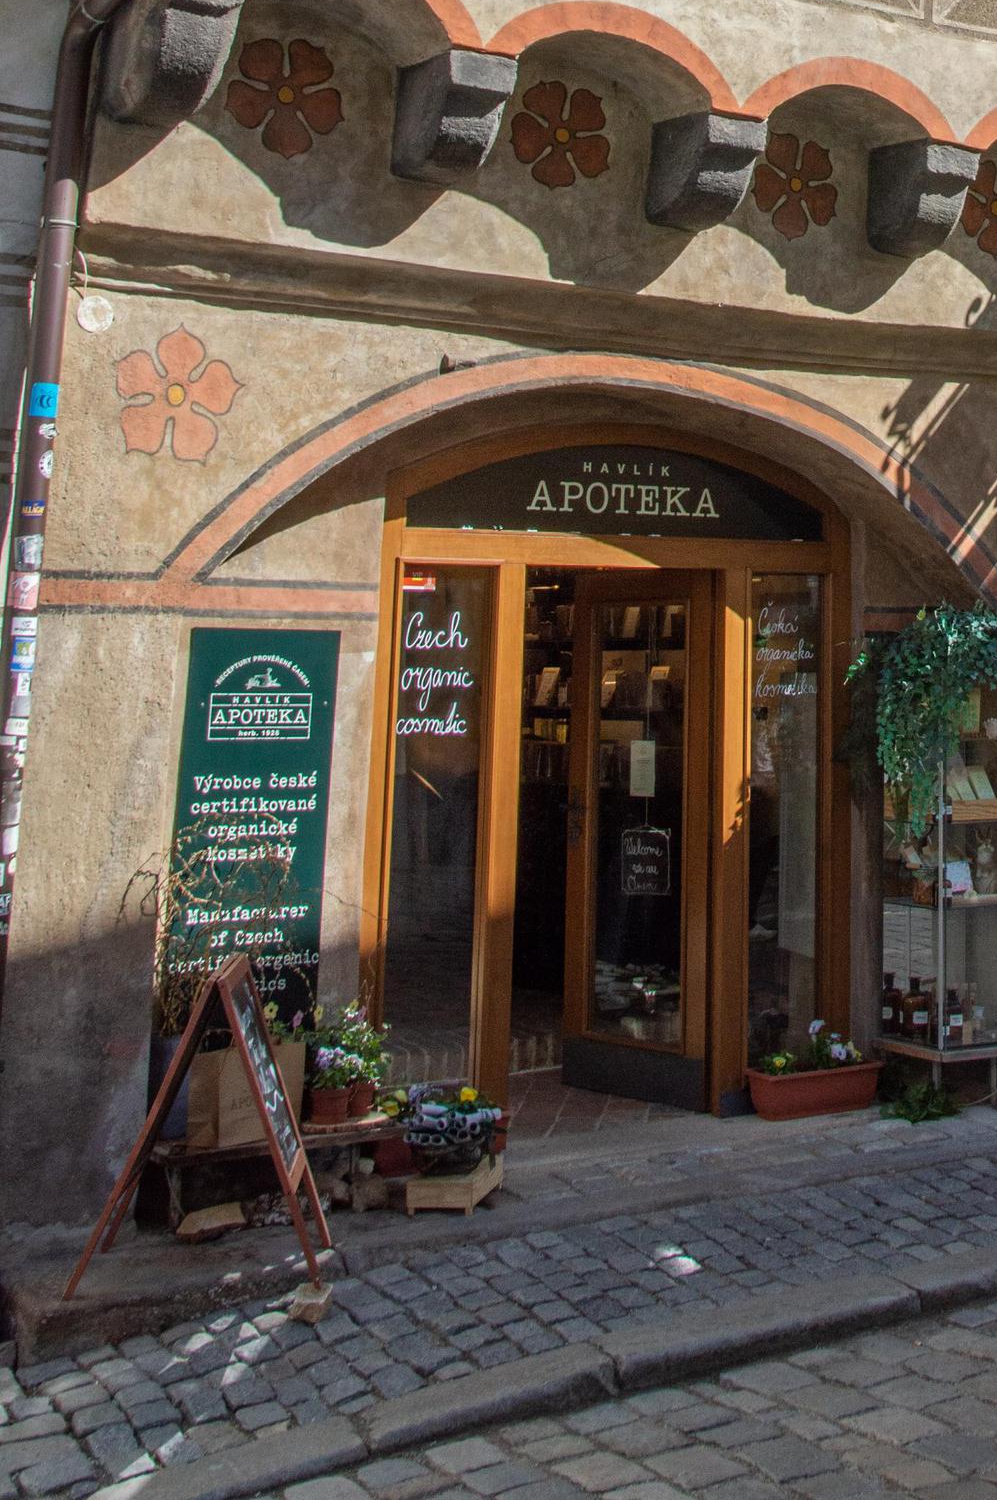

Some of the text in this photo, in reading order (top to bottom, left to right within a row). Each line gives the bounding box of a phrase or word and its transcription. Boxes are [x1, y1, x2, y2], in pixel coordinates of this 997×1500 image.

[583, 461, 671, 478] HAVLÍK
[526, 480, 720, 518] APOTEKA
[405, 611, 468, 649] Czech
[756, 638, 815, 676] organická
[401, 667, 474, 712] organic
[755, 672, 817, 698] kosmetika
[233, 695, 290, 704] HAVLÍK
[212, 709, 308, 724] APOTEKA
[395, 701, 468, 735] cosmetic
[194, 771, 317, 793] Výrobce české
[190, 794, 317, 814] certifikované
[208, 818, 298, 840] organické
[624, 837, 664, 857] Welcome
[235, 928, 284, 946] Czech
[256, 950, 319, 970] organic
